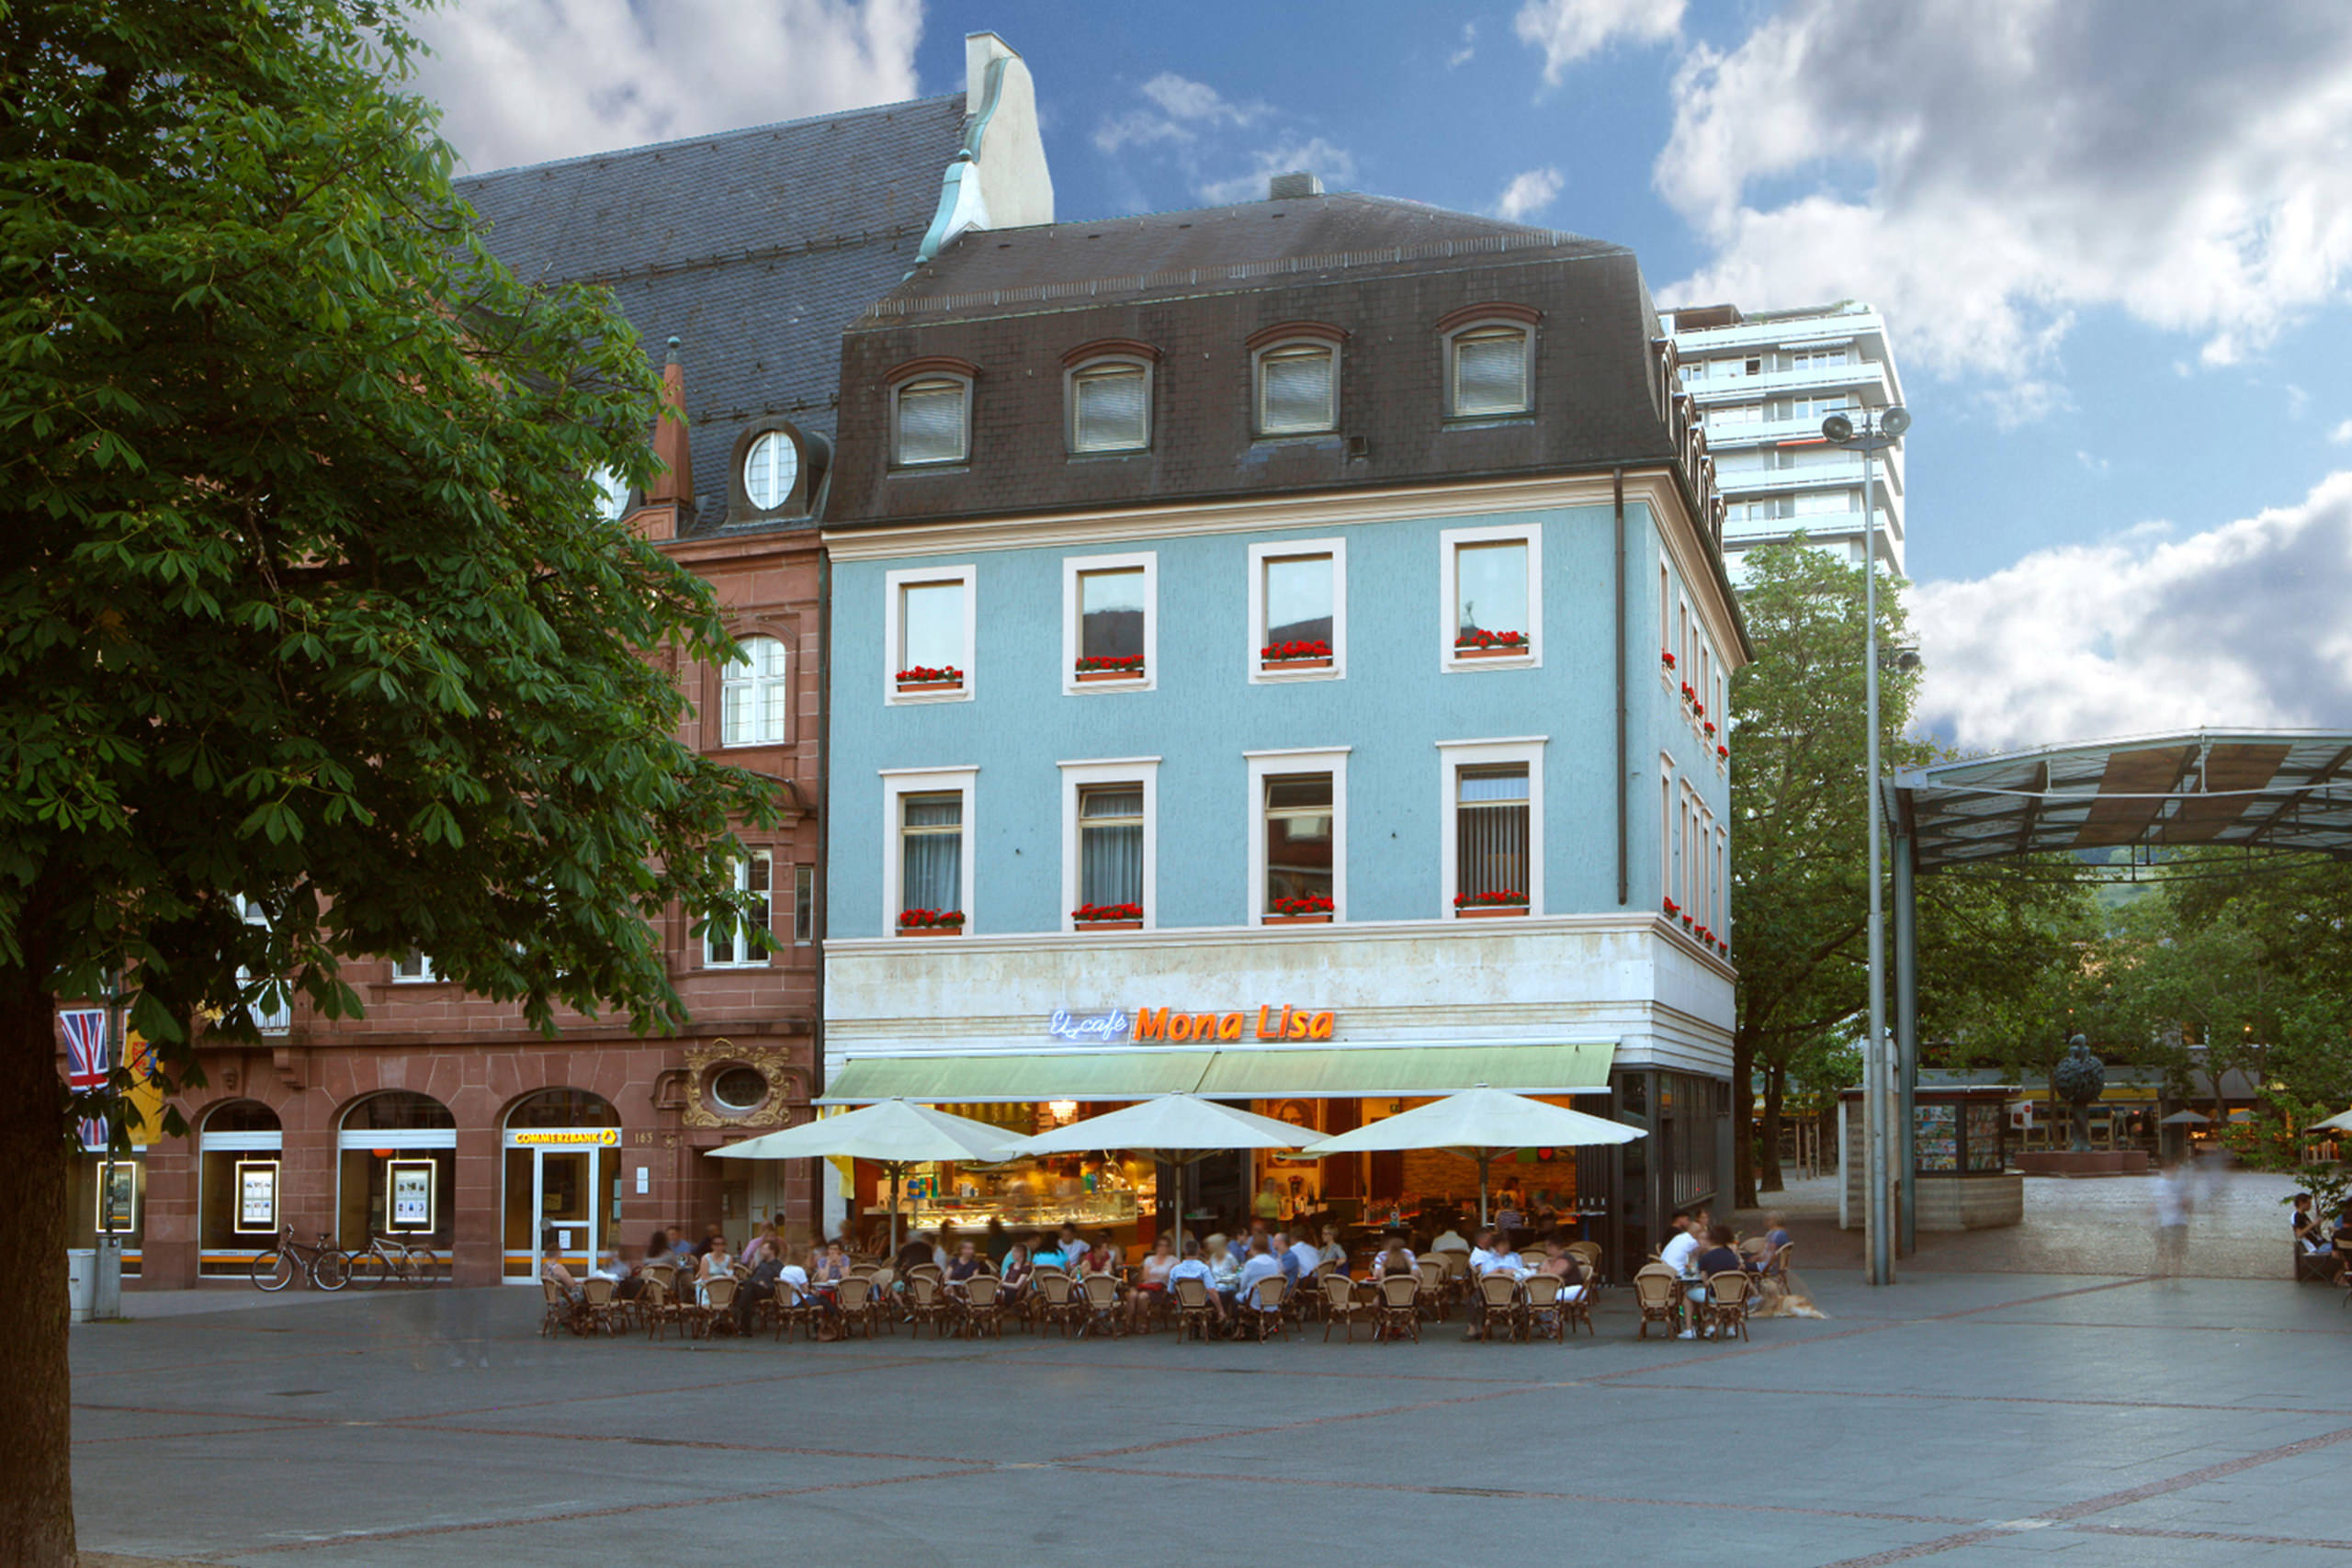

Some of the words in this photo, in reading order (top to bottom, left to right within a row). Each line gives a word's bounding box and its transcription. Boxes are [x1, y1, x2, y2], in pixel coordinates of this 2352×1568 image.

[1134, 1007, 1244, 1041] Mona
[1255, 1004, 1335, 1039] Lisa
[514, 1133, 600, 1145] COMMERZBANK
